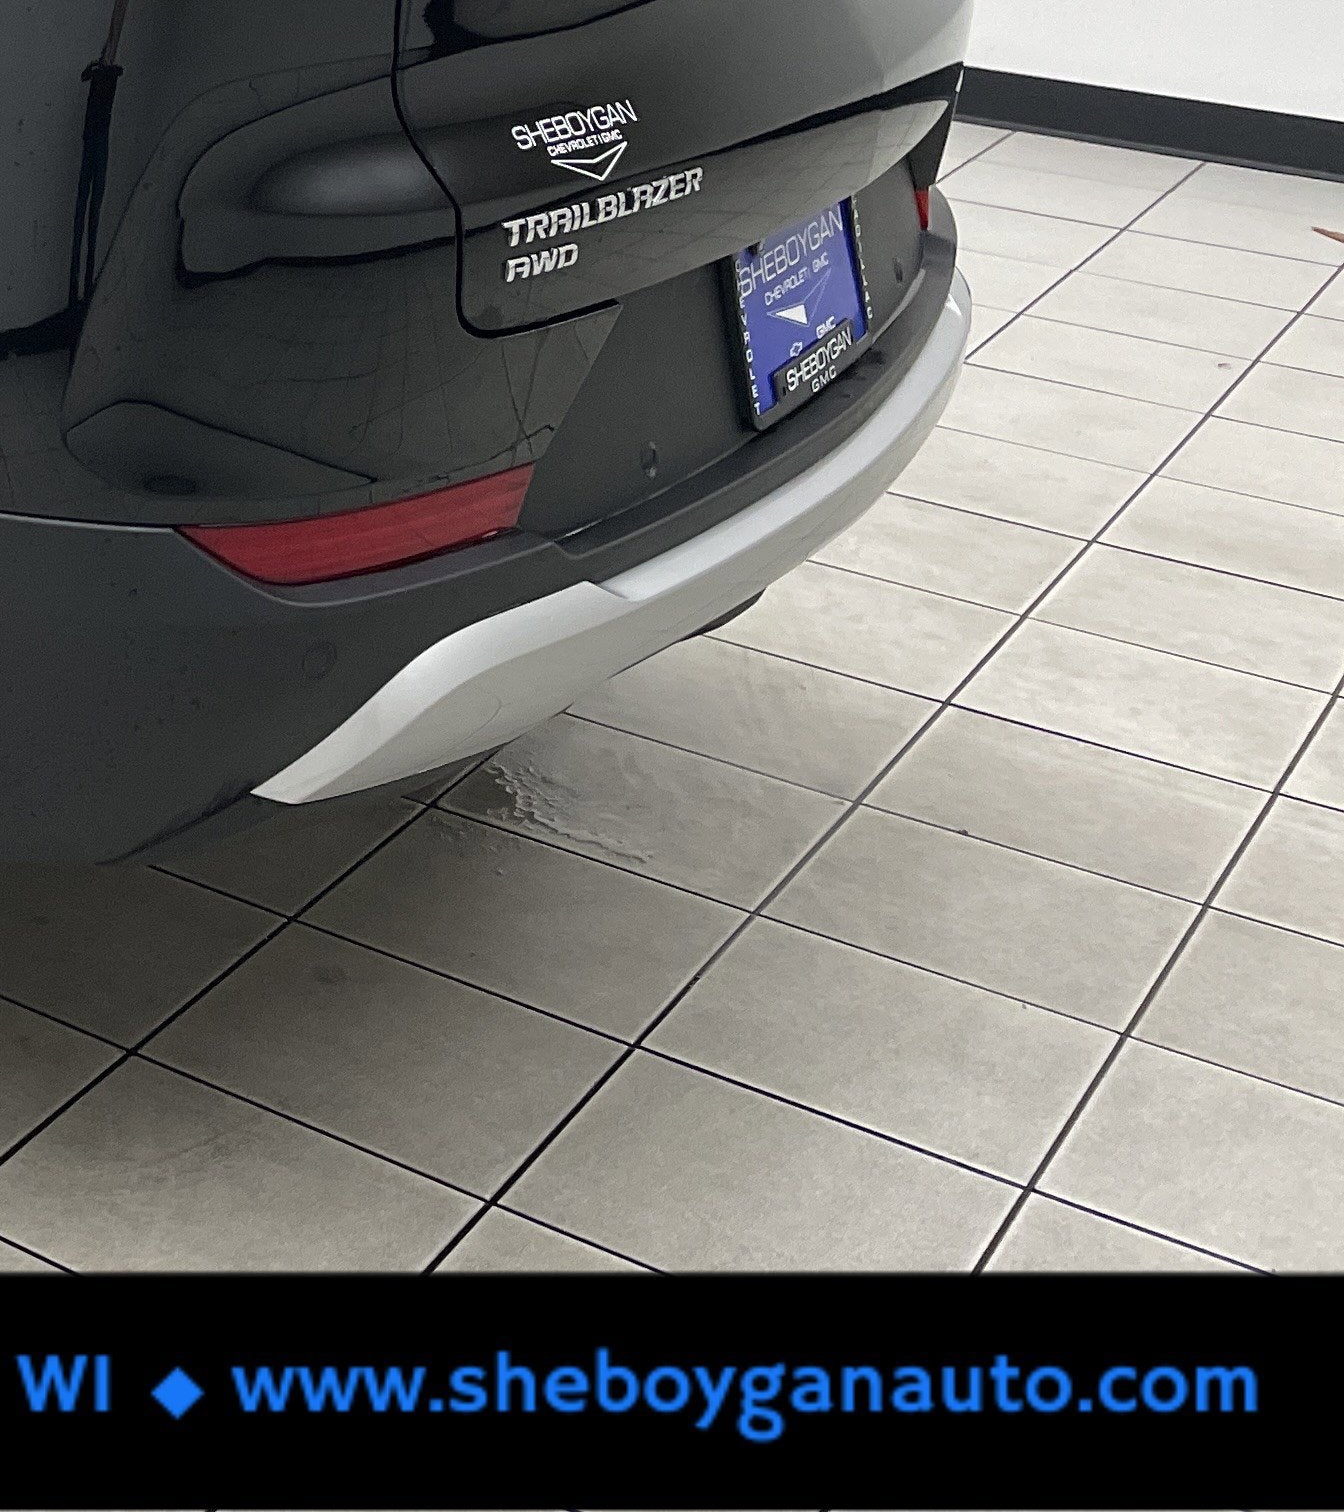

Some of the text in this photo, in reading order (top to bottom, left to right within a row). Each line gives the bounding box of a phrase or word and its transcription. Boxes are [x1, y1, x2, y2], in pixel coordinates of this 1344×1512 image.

[510, 98, 638, 150] SHEBOYGAN
[546, 135, 599, 157] CHEVROLET
[500, 165, 704, 247] TRAILBLAZER
[504, 243, 580, 283] AWD
[738, 201, 844, 297] SHEBOYGAN
[815, 315, 837, 339] GMC
[785, 325, 854, 393] SHEBOYGAN
[811, 365, 838, 394] GMC
